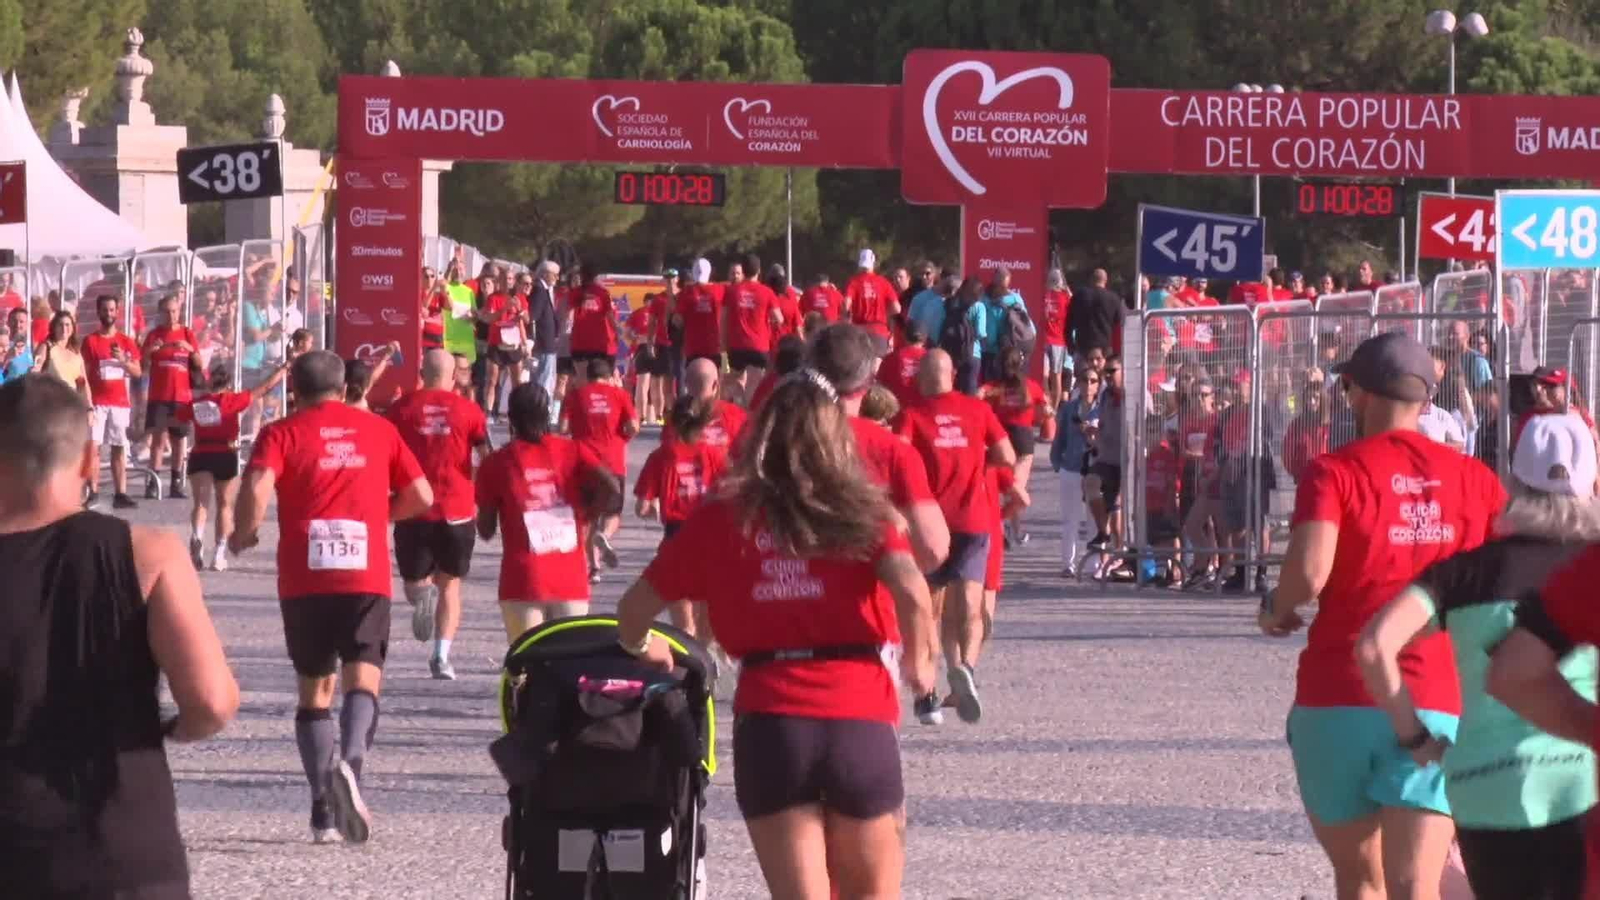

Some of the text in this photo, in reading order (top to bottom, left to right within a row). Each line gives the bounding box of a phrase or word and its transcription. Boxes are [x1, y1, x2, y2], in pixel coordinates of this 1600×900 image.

[617, 113, 668, 124] SOCIEDAD
[954, 110, 1087, 124] XVII CARRERA POPULAR
[1160, 95, 1461, 130] CARRERA POPULAR
[397, 107, 505, 136] MADRID
[748, 115, 808, 127] FUNDACIÓN
[617, 124, 683, 137] ESPAÑOLA DE
[748, 128, 819, 141] ESPAÑOLA DEL
[952, 125, 1088, 145] DEL CORAZÓN
[617, 138, 692, 150] CARDIOLOGÍA
[748, 140, 801, 152] CORAZÓN
[987, 147, 1052, 159] VII VIRTUAL
[1205, 132, 1425, 170] DEL CORAZÓN
[351, 246, 404, 257] 20minutos
[979, 258, 1031, 270] 20minutos
[316, 541, 360, 557] 1136
